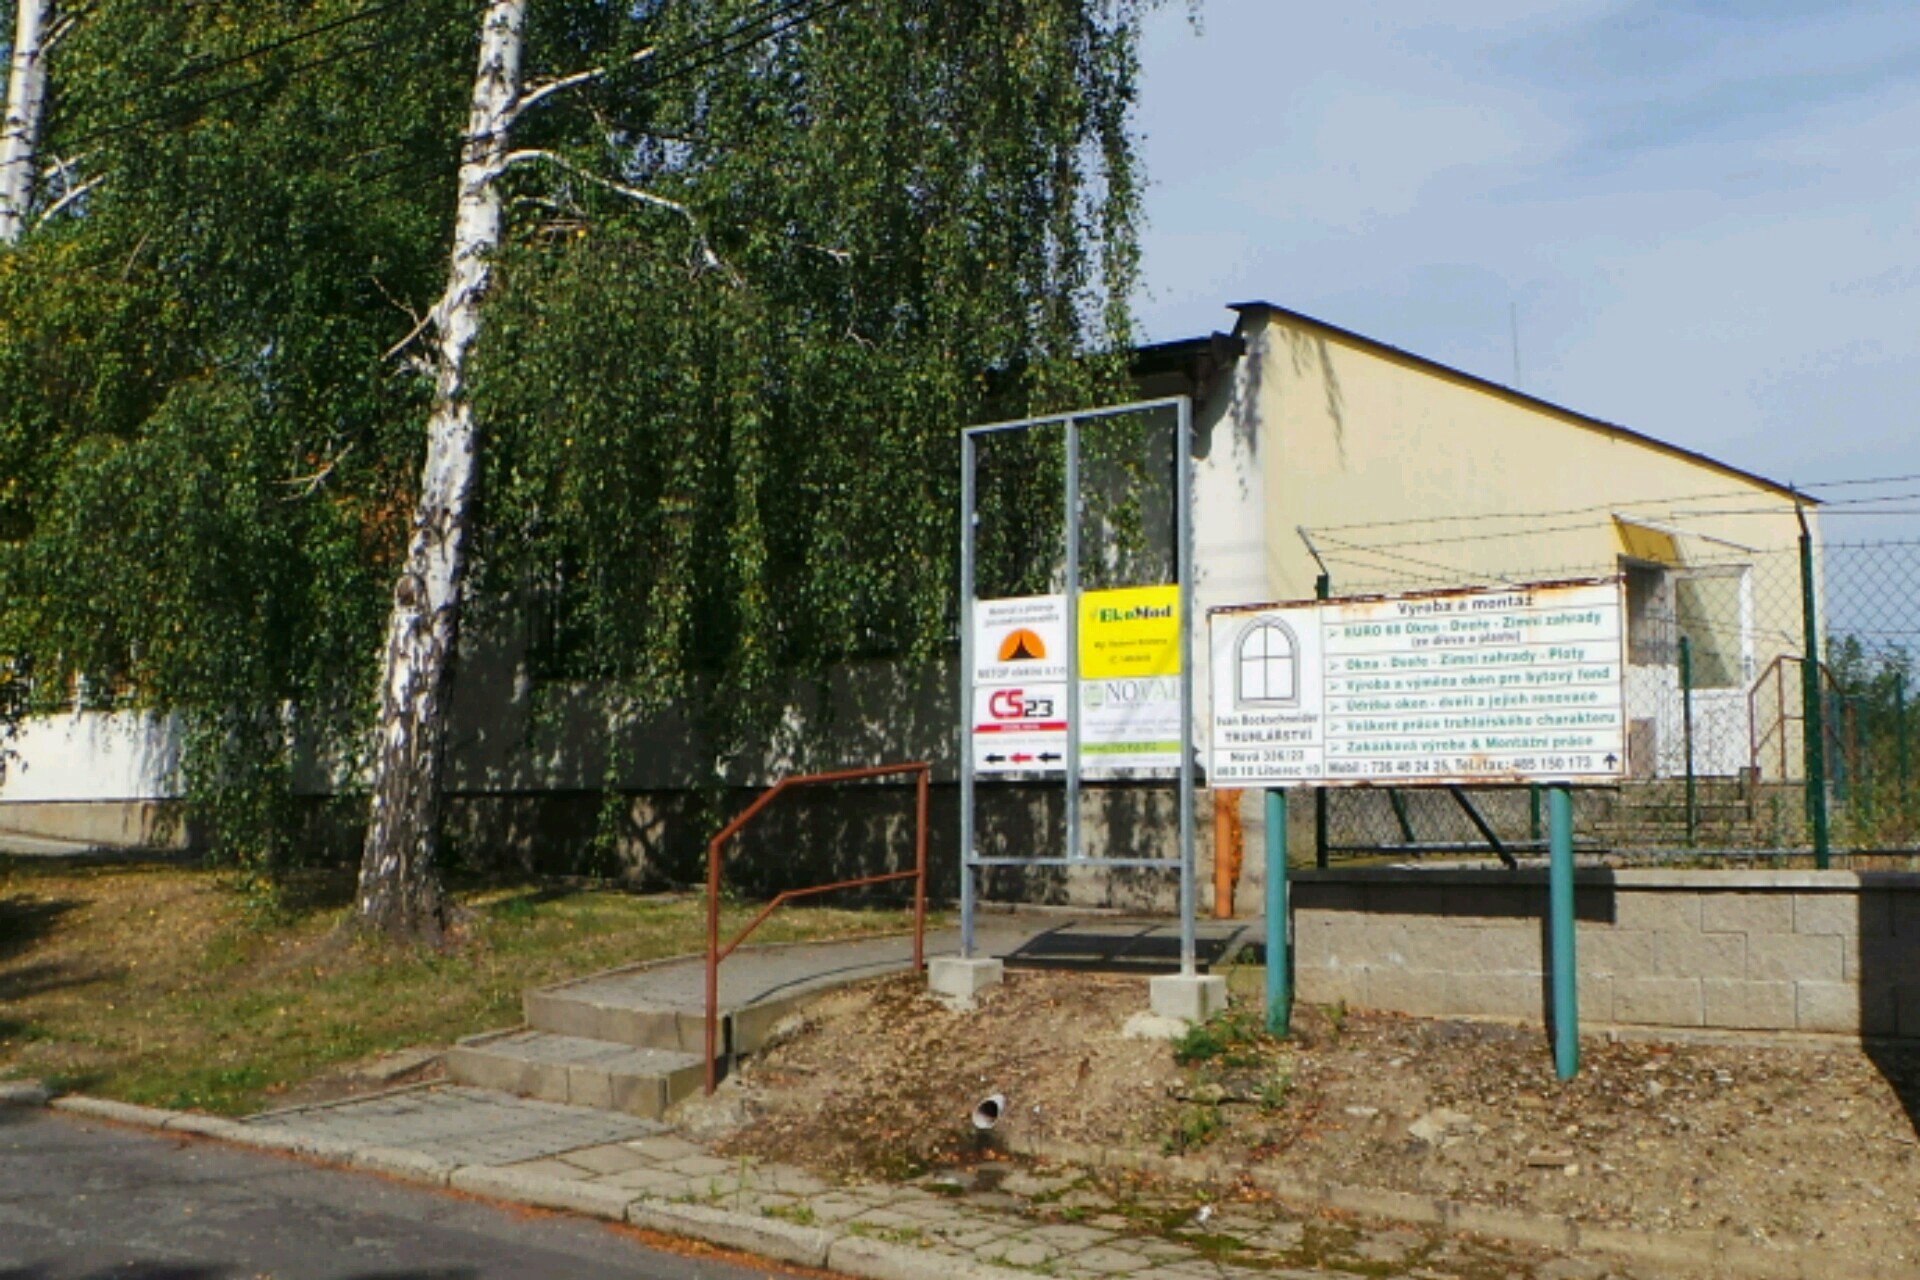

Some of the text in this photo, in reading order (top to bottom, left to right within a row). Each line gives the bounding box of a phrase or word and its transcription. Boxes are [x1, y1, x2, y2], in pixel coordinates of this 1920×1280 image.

[1458, 601, 1467, 612] a
[1344, 624, 1381, 637] EURO
[1405, 621, 1440, 634] Okna
[1450, 618, 1490, 632] Dveře
[1502, 614, 1541, 629] Zimní
[1546, 610, 1601, 626] zahrady
[1346, 657, 1380, 670] Okna
[1391, 655, 1429, 668] Dveře
[1440, 652, 1479, 665] Zimní
[1482, 649, 1536, 664] zahrady
[1549, 646, 1585, 662] Ploty
[1346, 677, 1390, 693] Výroba
[1395, 679, 1403, 690] a
[1461, 673, 1496, 687] oken
[1499, 672, 1521, 685] pro
[1525, 669, 1573, 685] bytový
[1577, 666, 1610, 680] fond
[988, 688, 1053, 719] CS23
[1395, 697, 1427, 709] oken
[1478, 695, 1485, 706] a
[1489, 692, 1529, 709] jejich
[1532, 691, 1598, 705] renovace
[1216, 716, 1240, 727] Ivan
[1346, 717, 1398, 731] Veškeré
[1402, 717, 1440, 733] práce
[1536, 711, 1616, 726] charakteru
[1422, 737, 1467, 753] výroba
[1471, 737, 1479, 748] &
[1553, 733, 1593, 750] práce
[1258, 763, 1302, 776] Liberec
